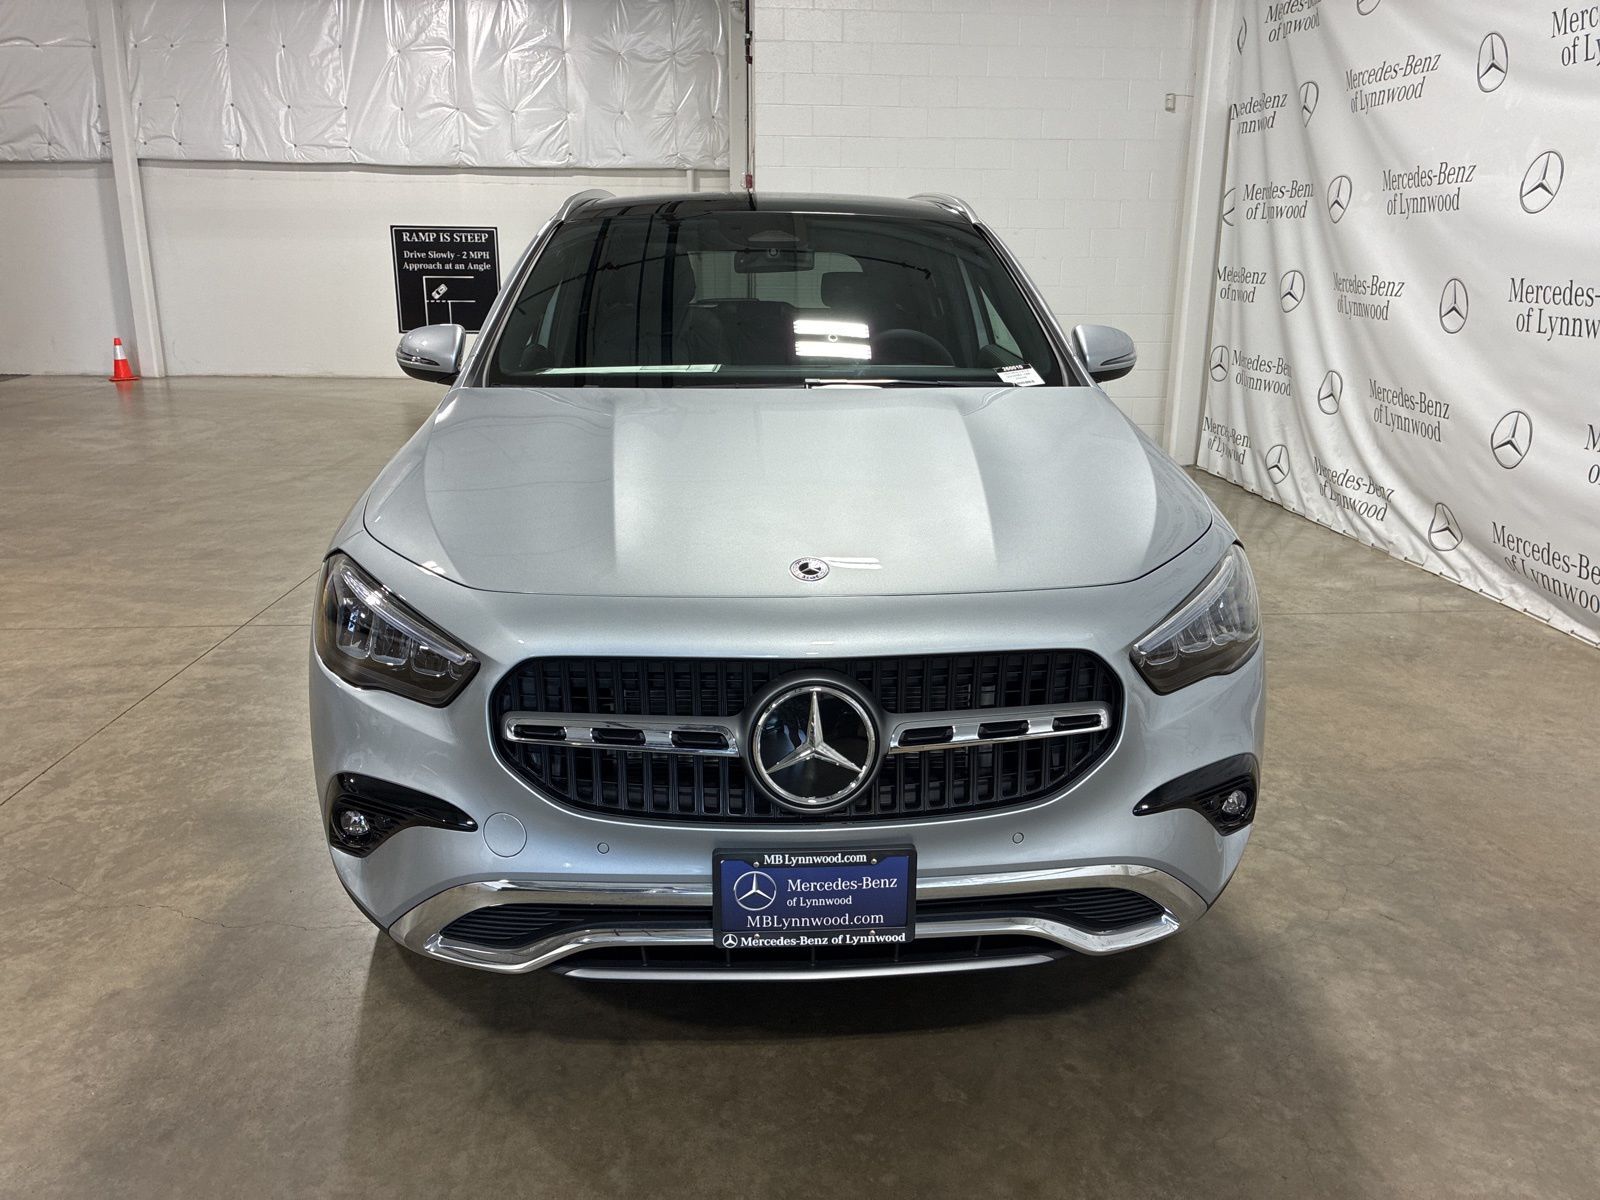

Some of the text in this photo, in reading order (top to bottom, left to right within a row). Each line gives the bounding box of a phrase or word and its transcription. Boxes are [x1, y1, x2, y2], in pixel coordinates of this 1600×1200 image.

[1561, 36, 1579, 67] of
[1345, 54, 1441, 91] Mercedes-Benz
[1350, 76, 1426, 115] of Lynnwood
[1382, 161, 1477, 191] Mercedes-Benz
[1246, 202, 1261, 220] of
[1386, 187, 1461, 220] of Lynnwood
[402, 232, 489, 243] RAMP IS STEEP
[402, 262, 442, 271] Approach
[467, 262, 491, 272] Angle
[403, 250, 426, 259] Drive
[428, 250, 456, 261] Slowly
[462, 251, 467, 259] 2
[469, 251, 490, 259] MPH
[1332, 271, 1405, 297] Mercedes-Benz
[1344, 295, 1390, 320] Lynnwood
[1516, 307, 1534, 333] of
[1369, 379, 1450, 420] Mercedes-Benz
[1374, 404, 1442, 442] of Lynnwood
[1504, 554, 1521, 575] of
[787, 876, 898, 892] Mercedes-Benz
[786, 895, 853, 908] of Lynnwood
[746, 913, 884, 930] MBLynnwood.com
[740, 933, 906, 947] Mercedes-Benz of Lynnwood
